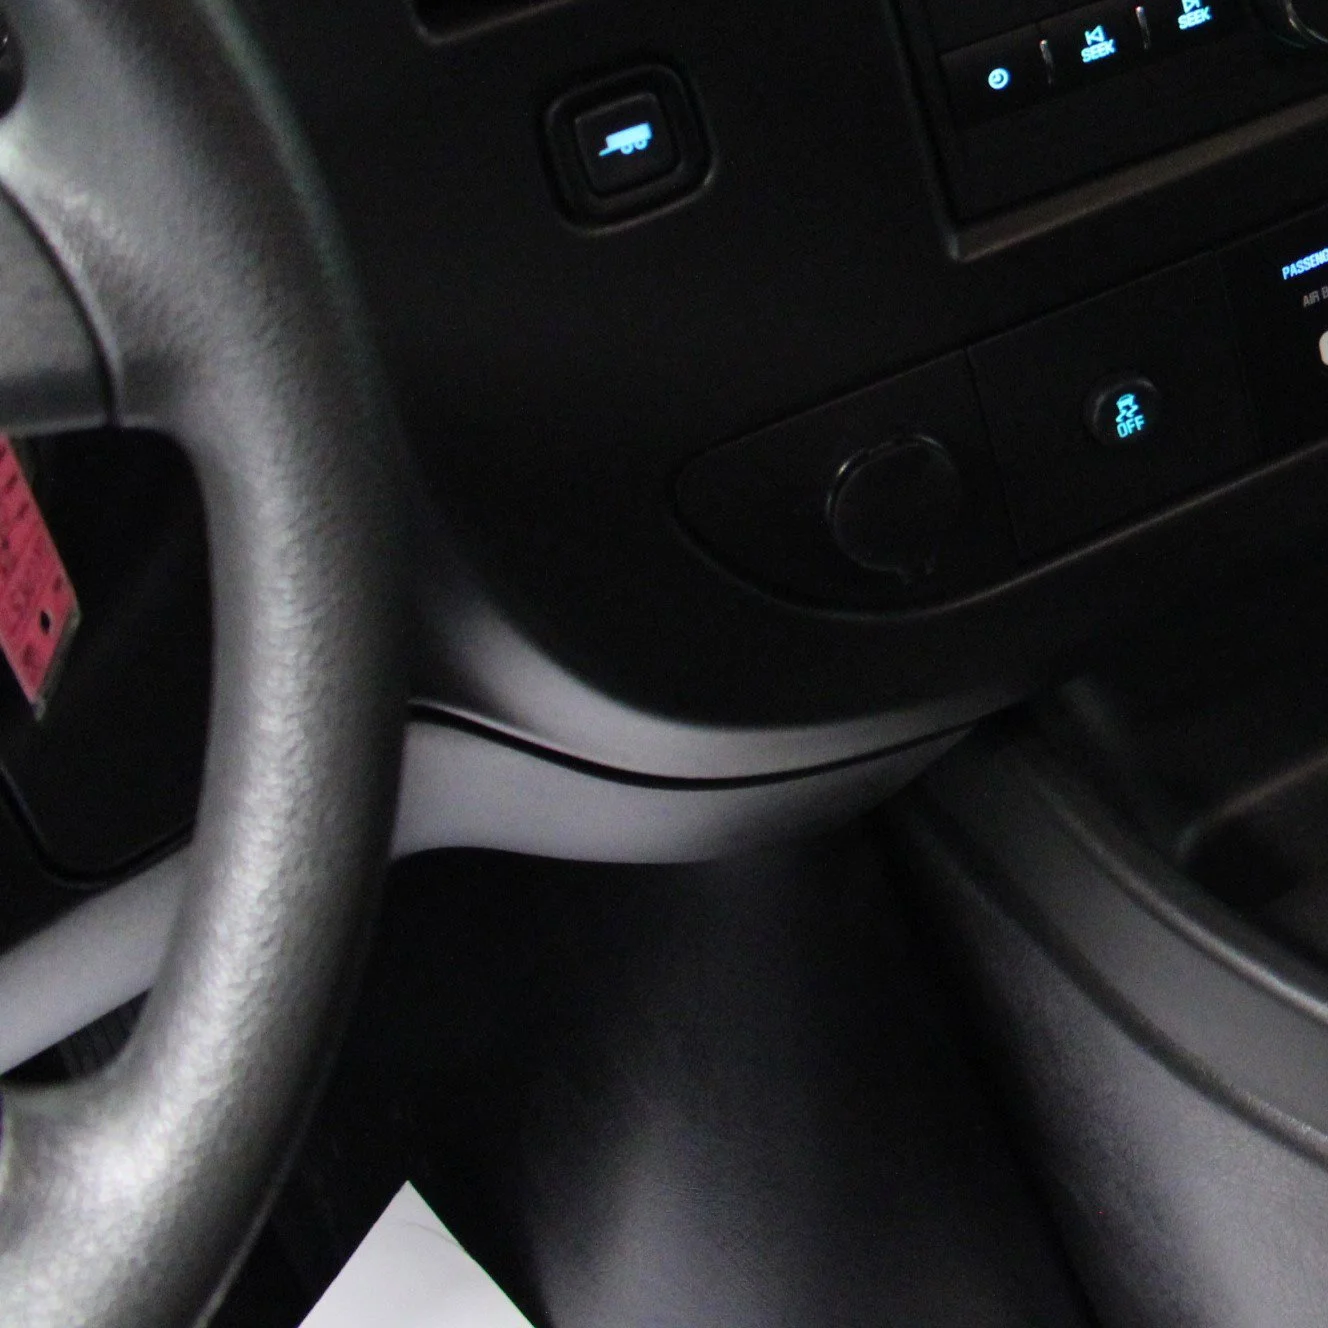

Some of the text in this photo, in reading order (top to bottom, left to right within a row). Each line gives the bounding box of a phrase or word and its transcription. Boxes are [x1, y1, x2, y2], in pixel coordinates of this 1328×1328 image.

[1178, 6, 1213, 30] SEEK
[1081, 38, 1116, 63] SEEK
[1302, 290, 1320, 307] AIR
[1116, 414, 1145, 438] OFF
